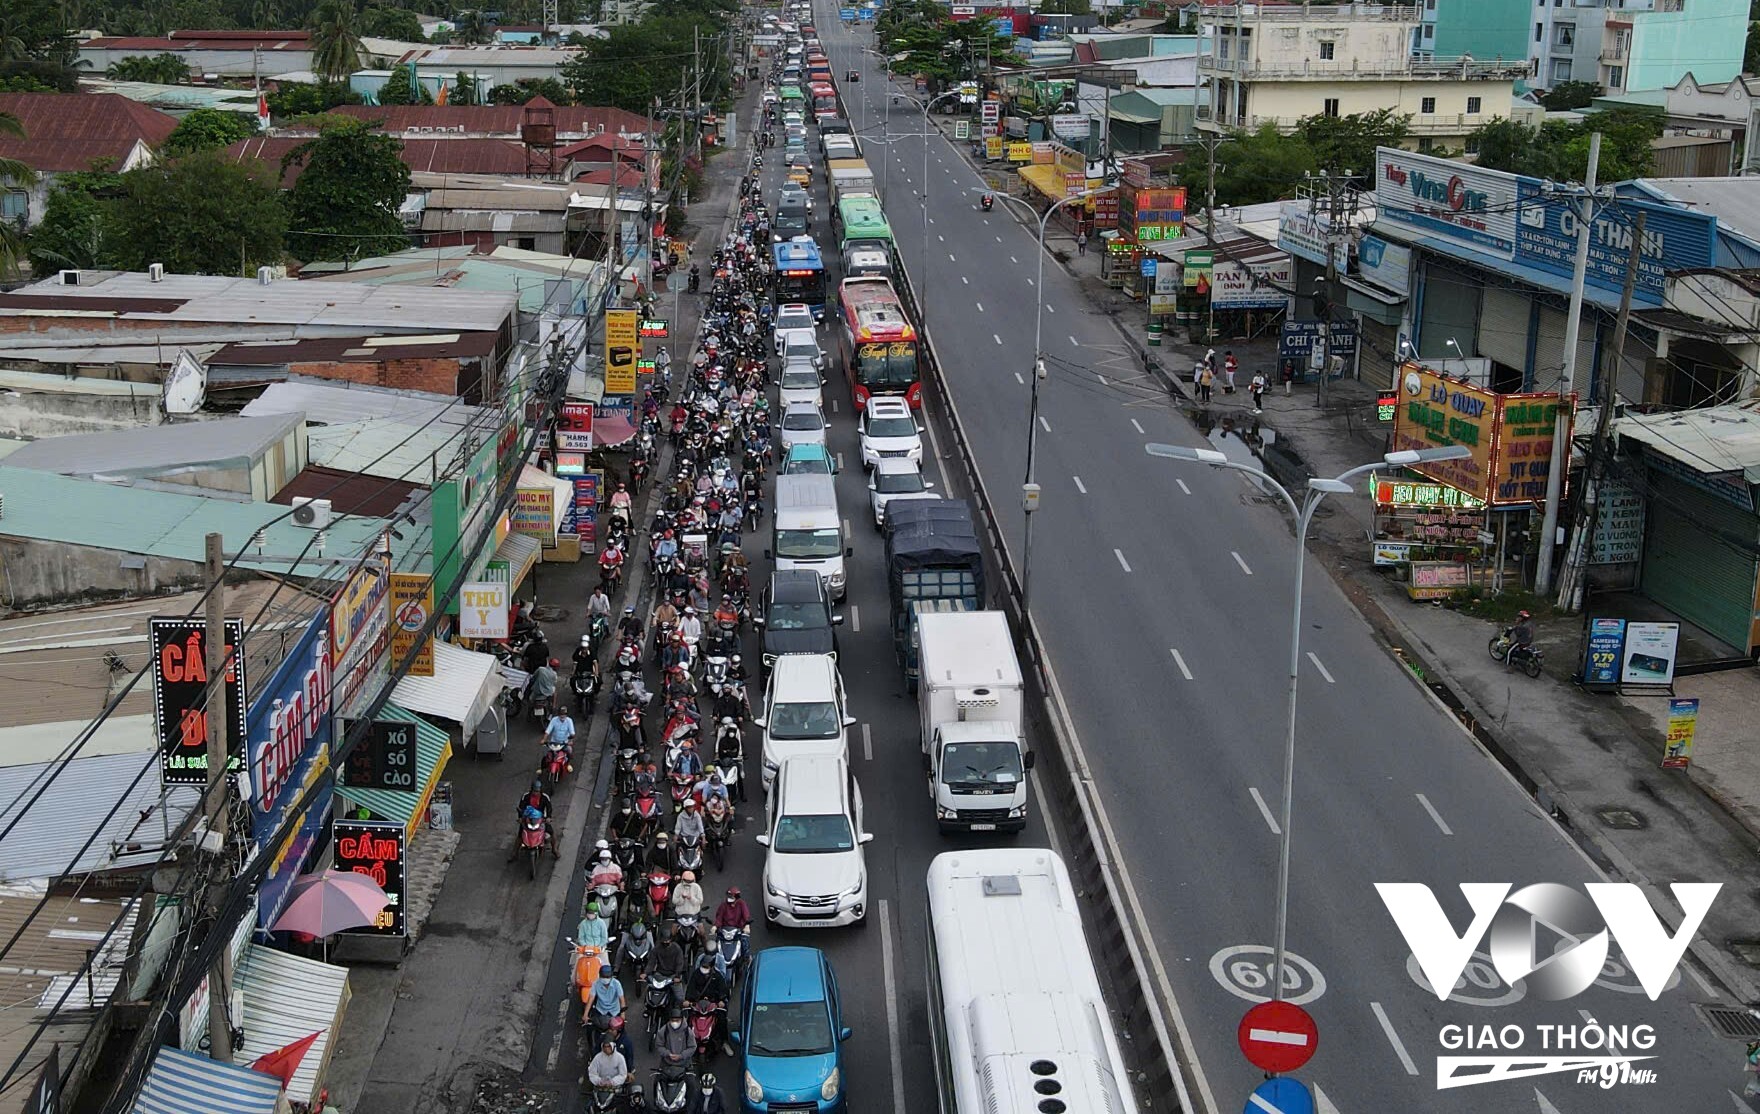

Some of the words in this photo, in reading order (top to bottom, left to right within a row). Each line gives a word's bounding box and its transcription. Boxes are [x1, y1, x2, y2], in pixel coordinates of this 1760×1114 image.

[1452, 391, 1486, 419] QUAY
[477, 610, 490, 625] Y
[383, 770, 411, 786] CÀO
[1231, 961, 1302, 990] 60
